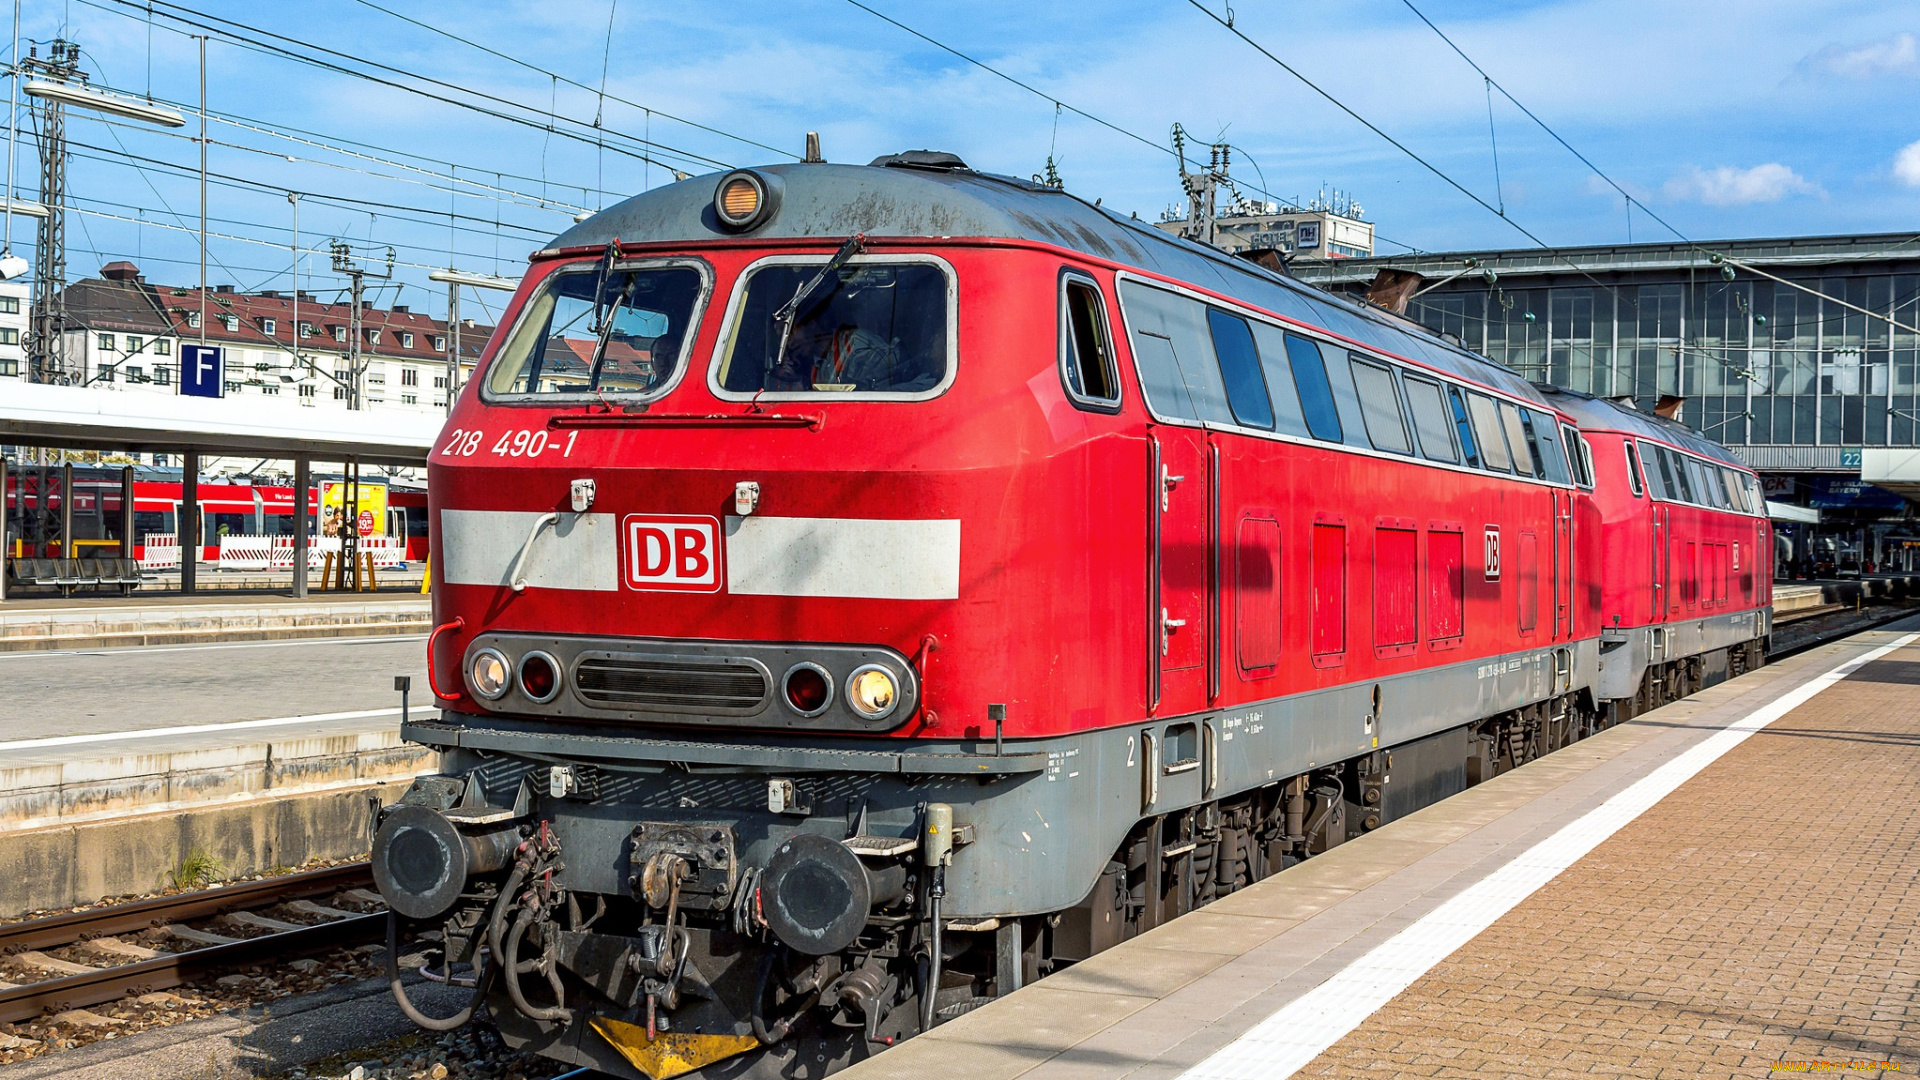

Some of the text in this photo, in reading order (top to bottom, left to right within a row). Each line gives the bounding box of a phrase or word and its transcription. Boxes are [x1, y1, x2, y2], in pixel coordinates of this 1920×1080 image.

[1251, 231, 1293, 245] HOTEL
[196, 348, 214, 385] F
[441, 428, 579, 458] 218 490-1
[1844, 453, 1861, 466] 22
[636, 526, 710, 579] DB
[1486, 534, 1499, 572] DB
[1127, 735, 1135, 767] 2
